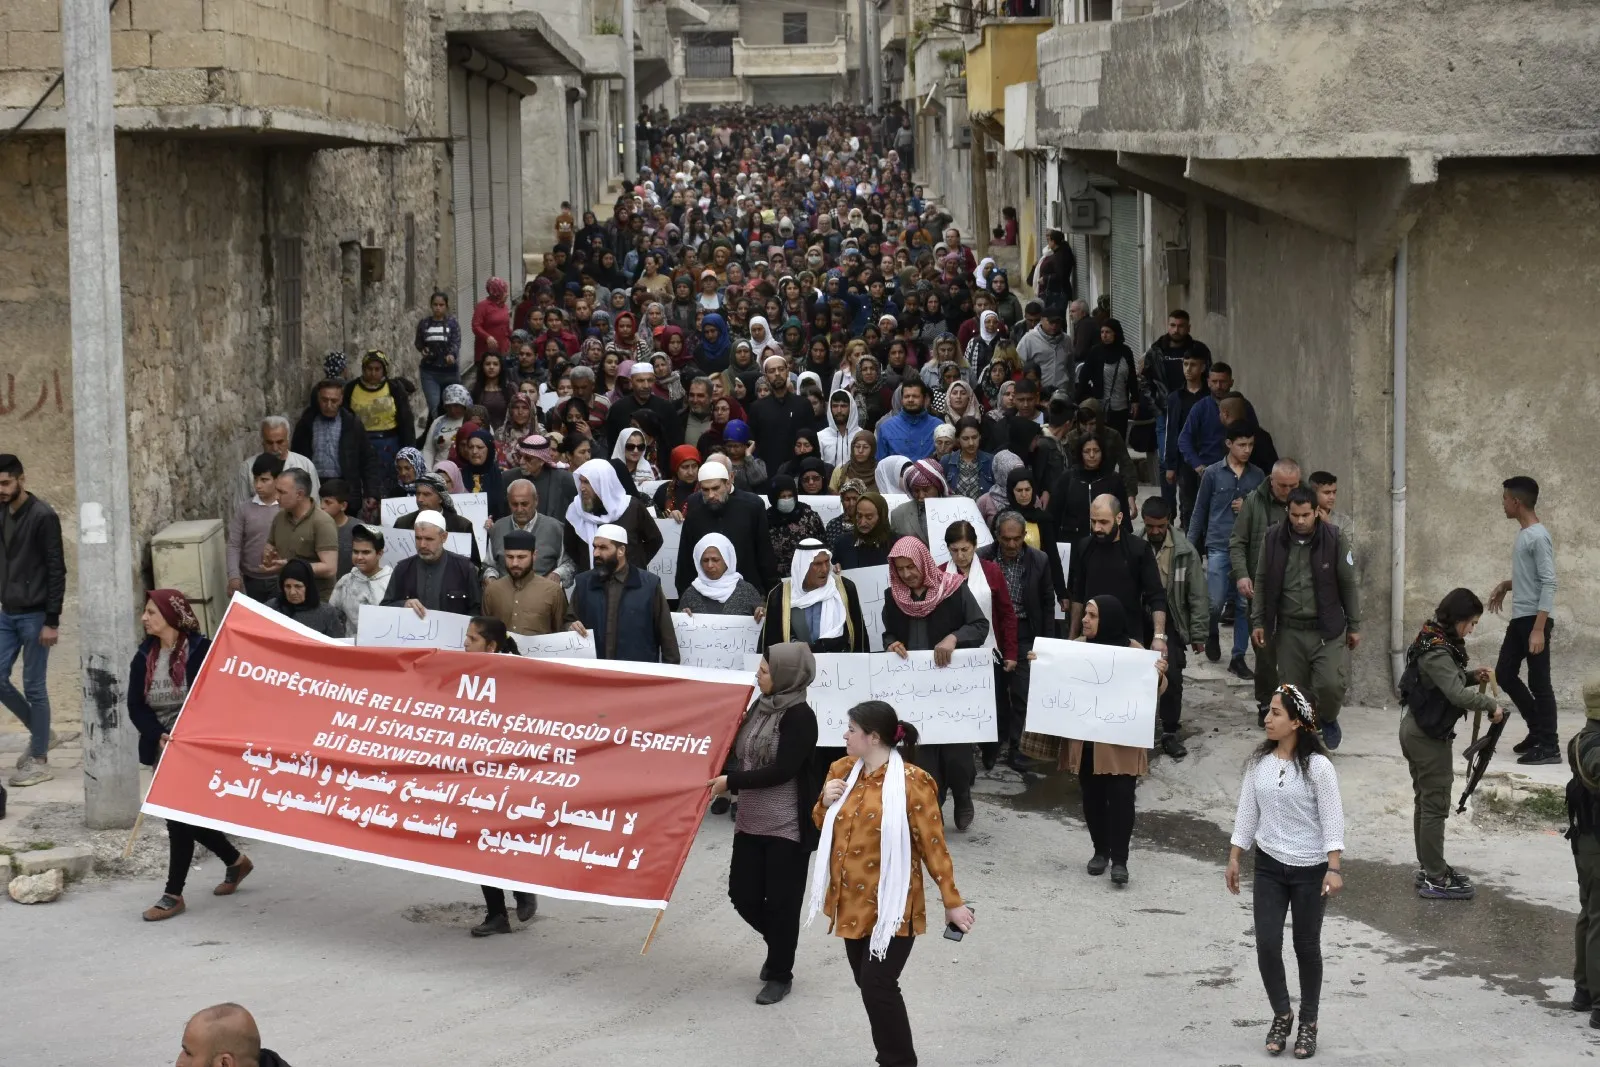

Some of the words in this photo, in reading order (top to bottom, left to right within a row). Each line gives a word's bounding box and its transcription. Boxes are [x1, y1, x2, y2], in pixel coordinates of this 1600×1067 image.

[386, 503, 408, 517] Na
[375, 615, 439, 642] للحصار
[1069, 651, 1116, 685] لا
[456, 674, 496, 703] NA
[368, 693, 394, 711] RE
[411, 701, 446, 720] SER
[447, 706, 503, 729] TAXÊN
[502, 714, 611, 742] ŞÊXMEQSÛD
[613, 726, 628, 745] Û
[331, 711, 357, 730] NA
[553, 748, 577, 766] RE
[241, 743, 319, 780] الأشرفية
[318, 765, 333, 787] و
[346, 738, 468, 774] BERXWEDANA
[472, 761, 531, 782] GELÊN
[528, 769, 581, 788] AZAD
[208, 769, 262, 799] الحرة
[335, 770, 397, 792] مقصود
[400, 775, 460, 804] الشيخ
[261, 791, 338, 816] الشعوب
[336, 796, 399, 829] مقاومة
[458, 785, 510, 814] أحياء
[506, 796, 546, 821] على
[402, 813, 458, 839] عاشت
[546, 801, 616, 832] للحصار
[622, 811, 638, 835] لا
[477, 828, 553, 857] التجويع
[554, 835, 624, 869] لسياسة
[627, 848, 644, 870] لا
